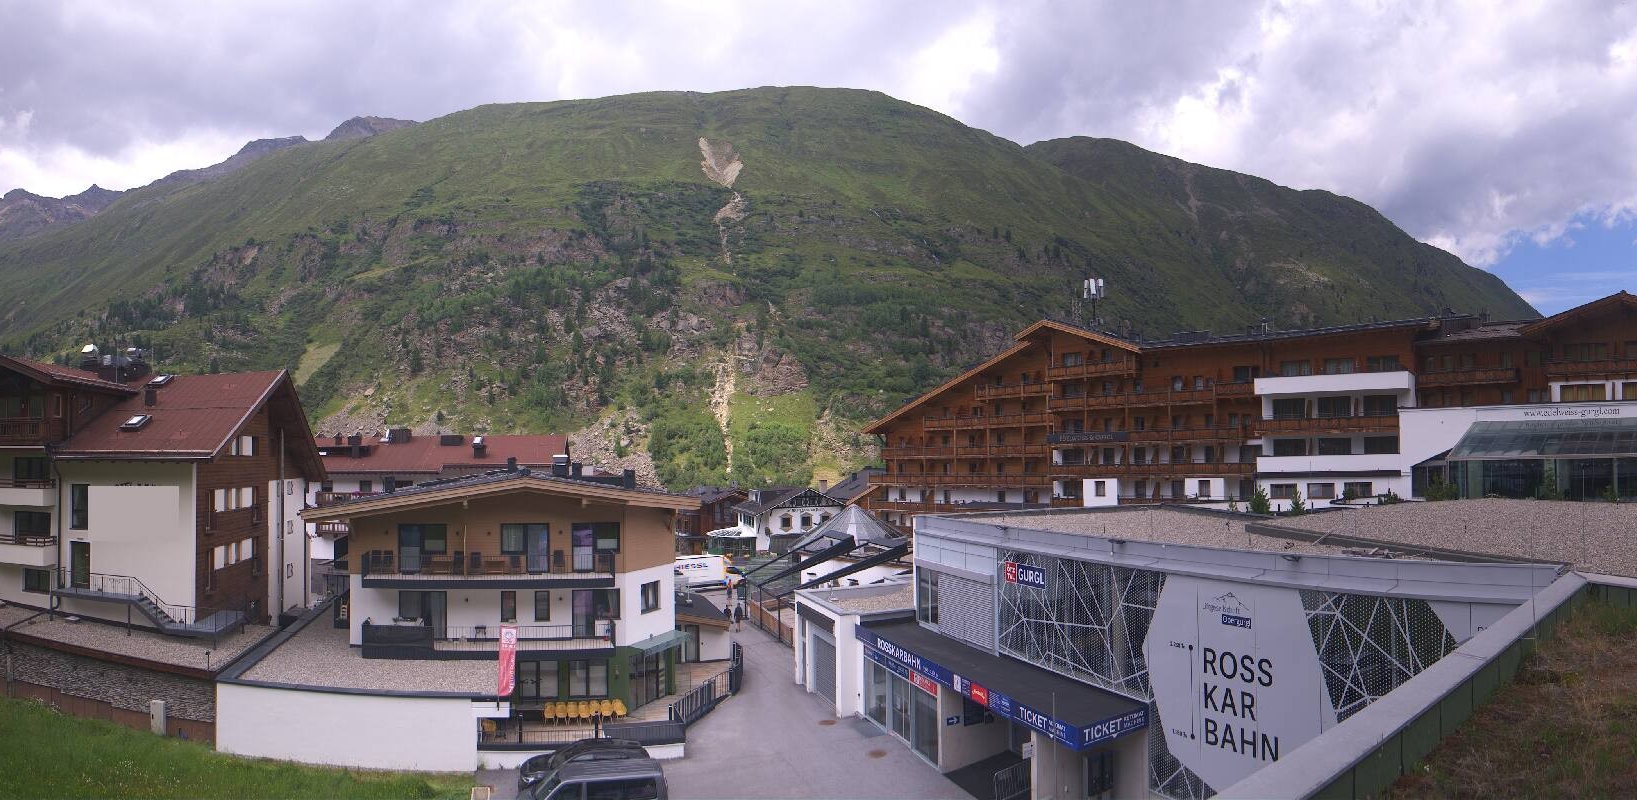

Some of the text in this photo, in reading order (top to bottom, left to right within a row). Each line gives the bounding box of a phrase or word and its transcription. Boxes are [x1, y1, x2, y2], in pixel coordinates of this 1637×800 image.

[1018, 568, 1045, 585] GURGL
[877, 637, 921, 671] ROSSKARBAHN
[1203, 647, 1273, 687] ROSS
[1020, 706, 1048, 729] TICKET
[1204, 682, 1257, 722] KAR
[1084, 717, 1123, 742] TICKET
[1204, 717, 1279, 762] BAHN
